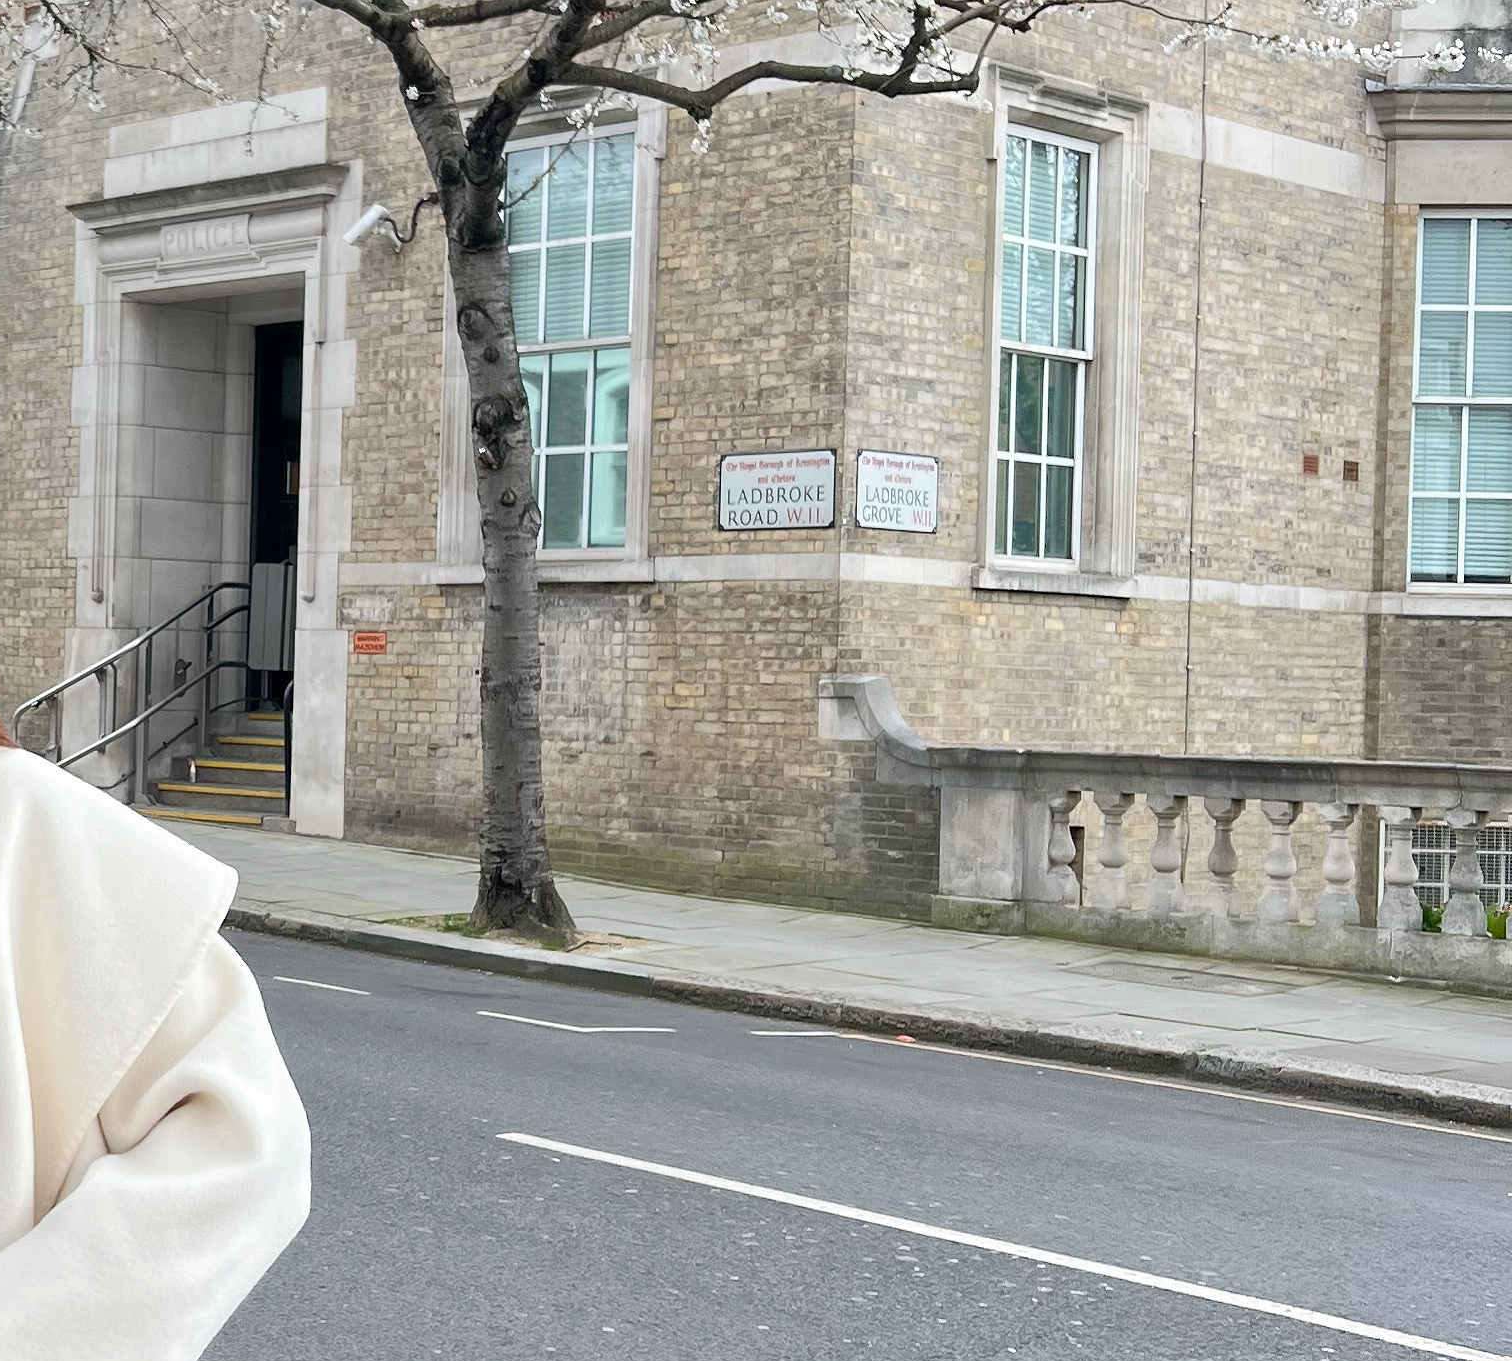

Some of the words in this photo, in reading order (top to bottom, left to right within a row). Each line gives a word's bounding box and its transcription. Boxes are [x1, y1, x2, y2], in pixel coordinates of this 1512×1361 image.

[164, 221, 246, 256] POLICE
[727, 485, 826, 506] LADBROKE
[865, 485, 929, 507] LADBROKE
